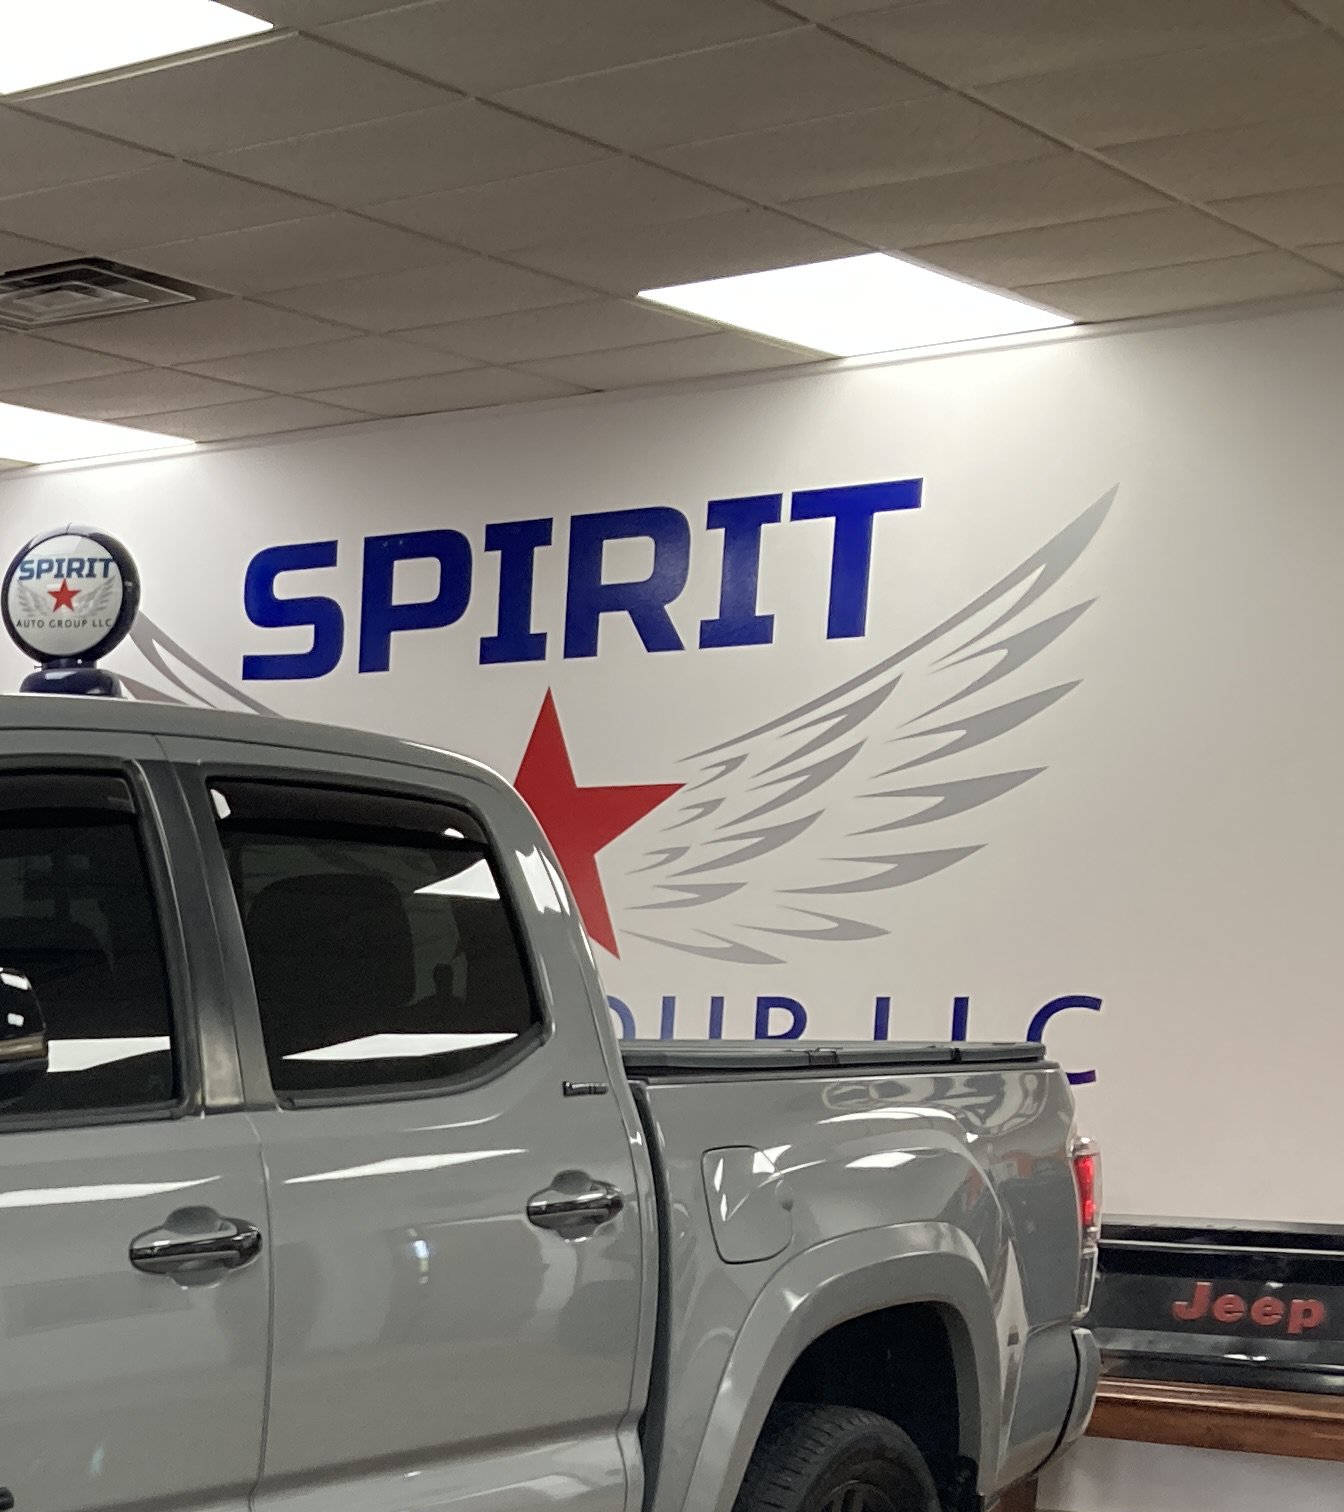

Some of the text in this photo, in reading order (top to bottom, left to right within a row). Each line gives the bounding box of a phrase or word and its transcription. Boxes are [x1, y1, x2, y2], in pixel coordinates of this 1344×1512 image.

[18, 557, 116, 580] SPIRIT
[241, 478, 924, 681] SPIRIT
[16, 619, 114, 629] AUTO GROUP LLC
[1172, 1280, 1325, 1334] Jeep
